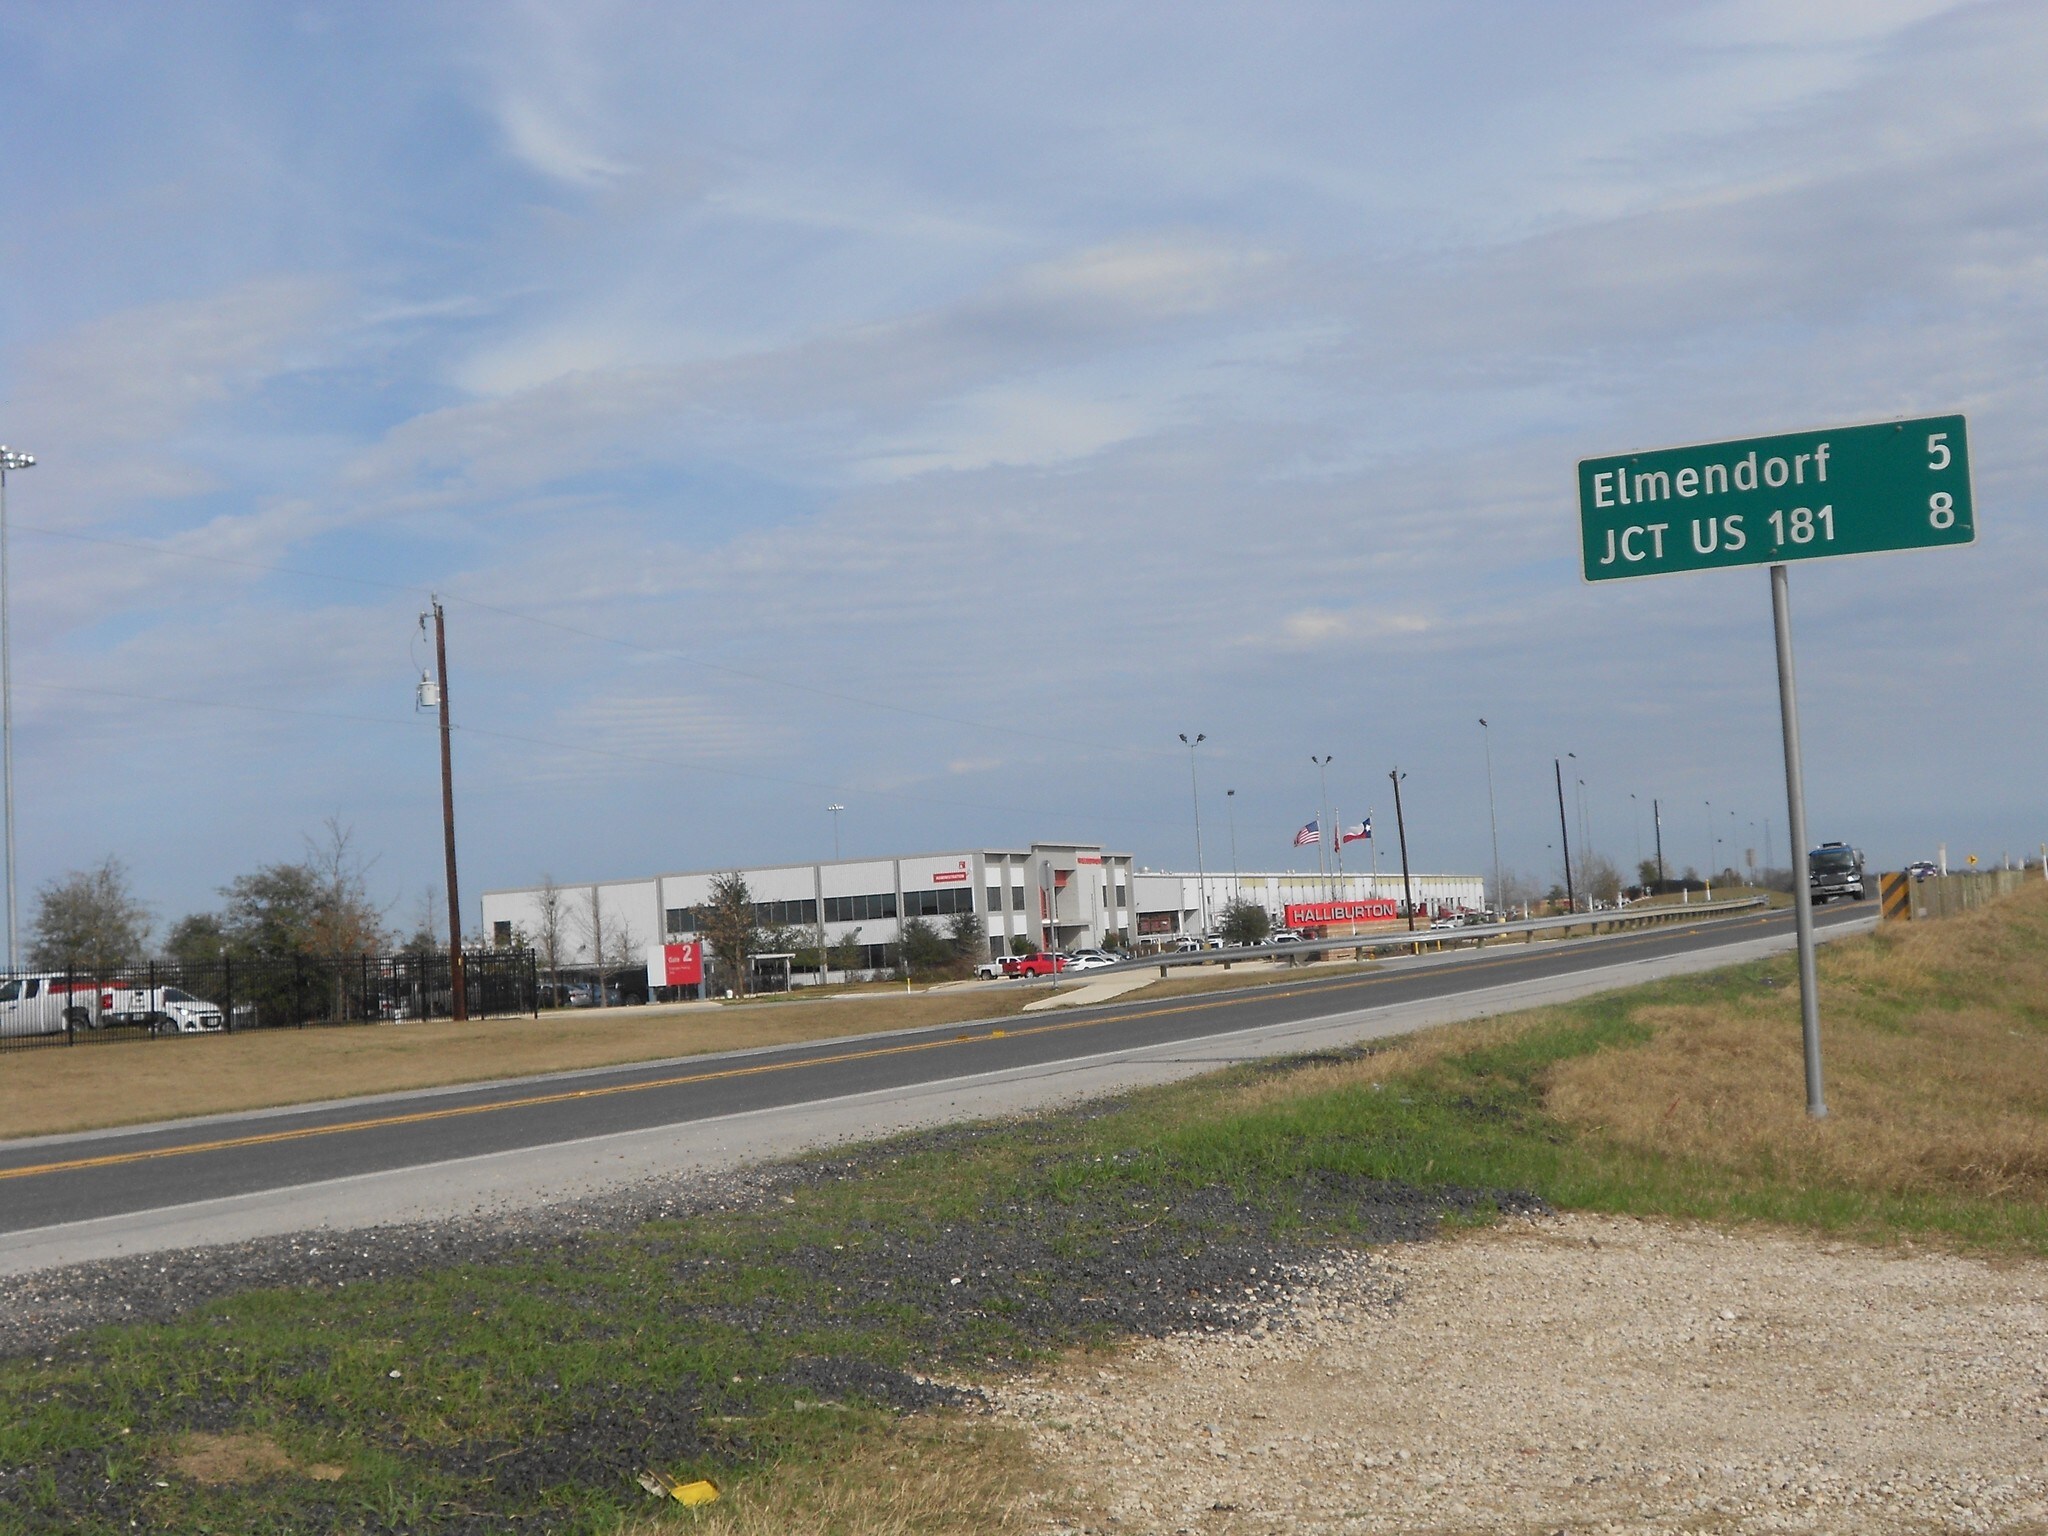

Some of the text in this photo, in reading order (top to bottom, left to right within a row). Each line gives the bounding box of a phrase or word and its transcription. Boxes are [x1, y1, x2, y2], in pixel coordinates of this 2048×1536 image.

[1594, 433, 1951, 508] Elmendorf 5
[1600, 491, 1955, 565] JCT US 181 8
[1293, 903, 1394, 923] HALLIBURTON
[682, 945, 693, 962] 2
